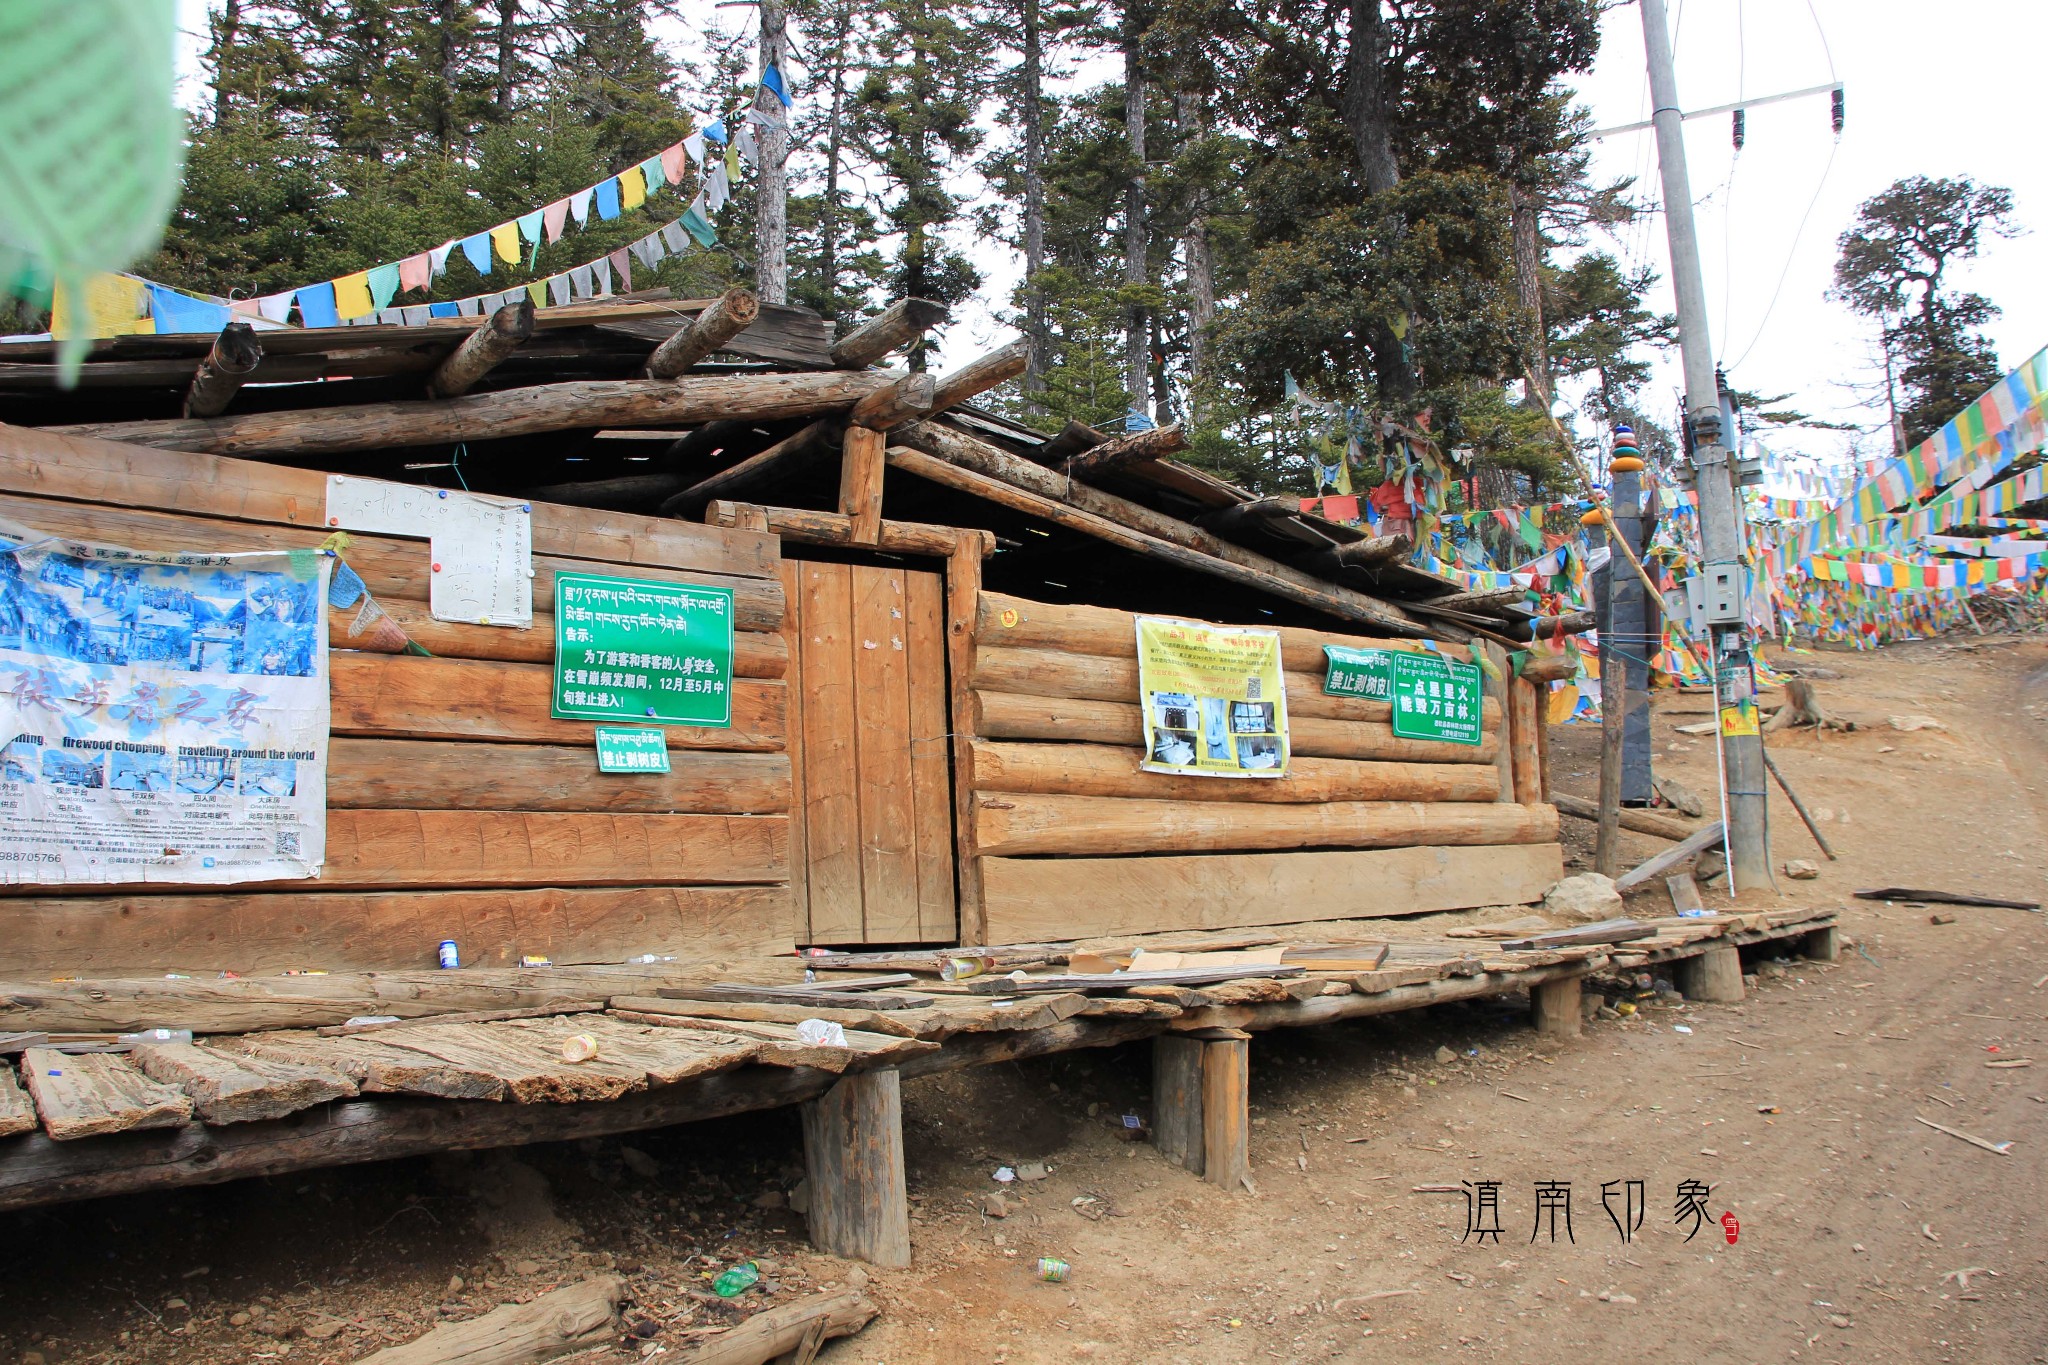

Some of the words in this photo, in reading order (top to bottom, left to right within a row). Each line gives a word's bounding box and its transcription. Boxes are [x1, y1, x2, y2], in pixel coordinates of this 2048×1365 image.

[584, 649, 720, 676] 为了游客和香客的人身安全，
[14, 669, 261, 730] 徒步者之家
[563, 690, 624, 708] 旬禁止进入！
[1399, 679, 1475, 703] 一点星星火，
[1400, 695, 1475, 721] 能毁万亩林。
[63, 736, 112, 750] firewood
[179, 746, 229, 759] travelling
[232, 748, 267, 760] around
[269, 749, 285, 760] the
[287, 750, 315, 761] world
